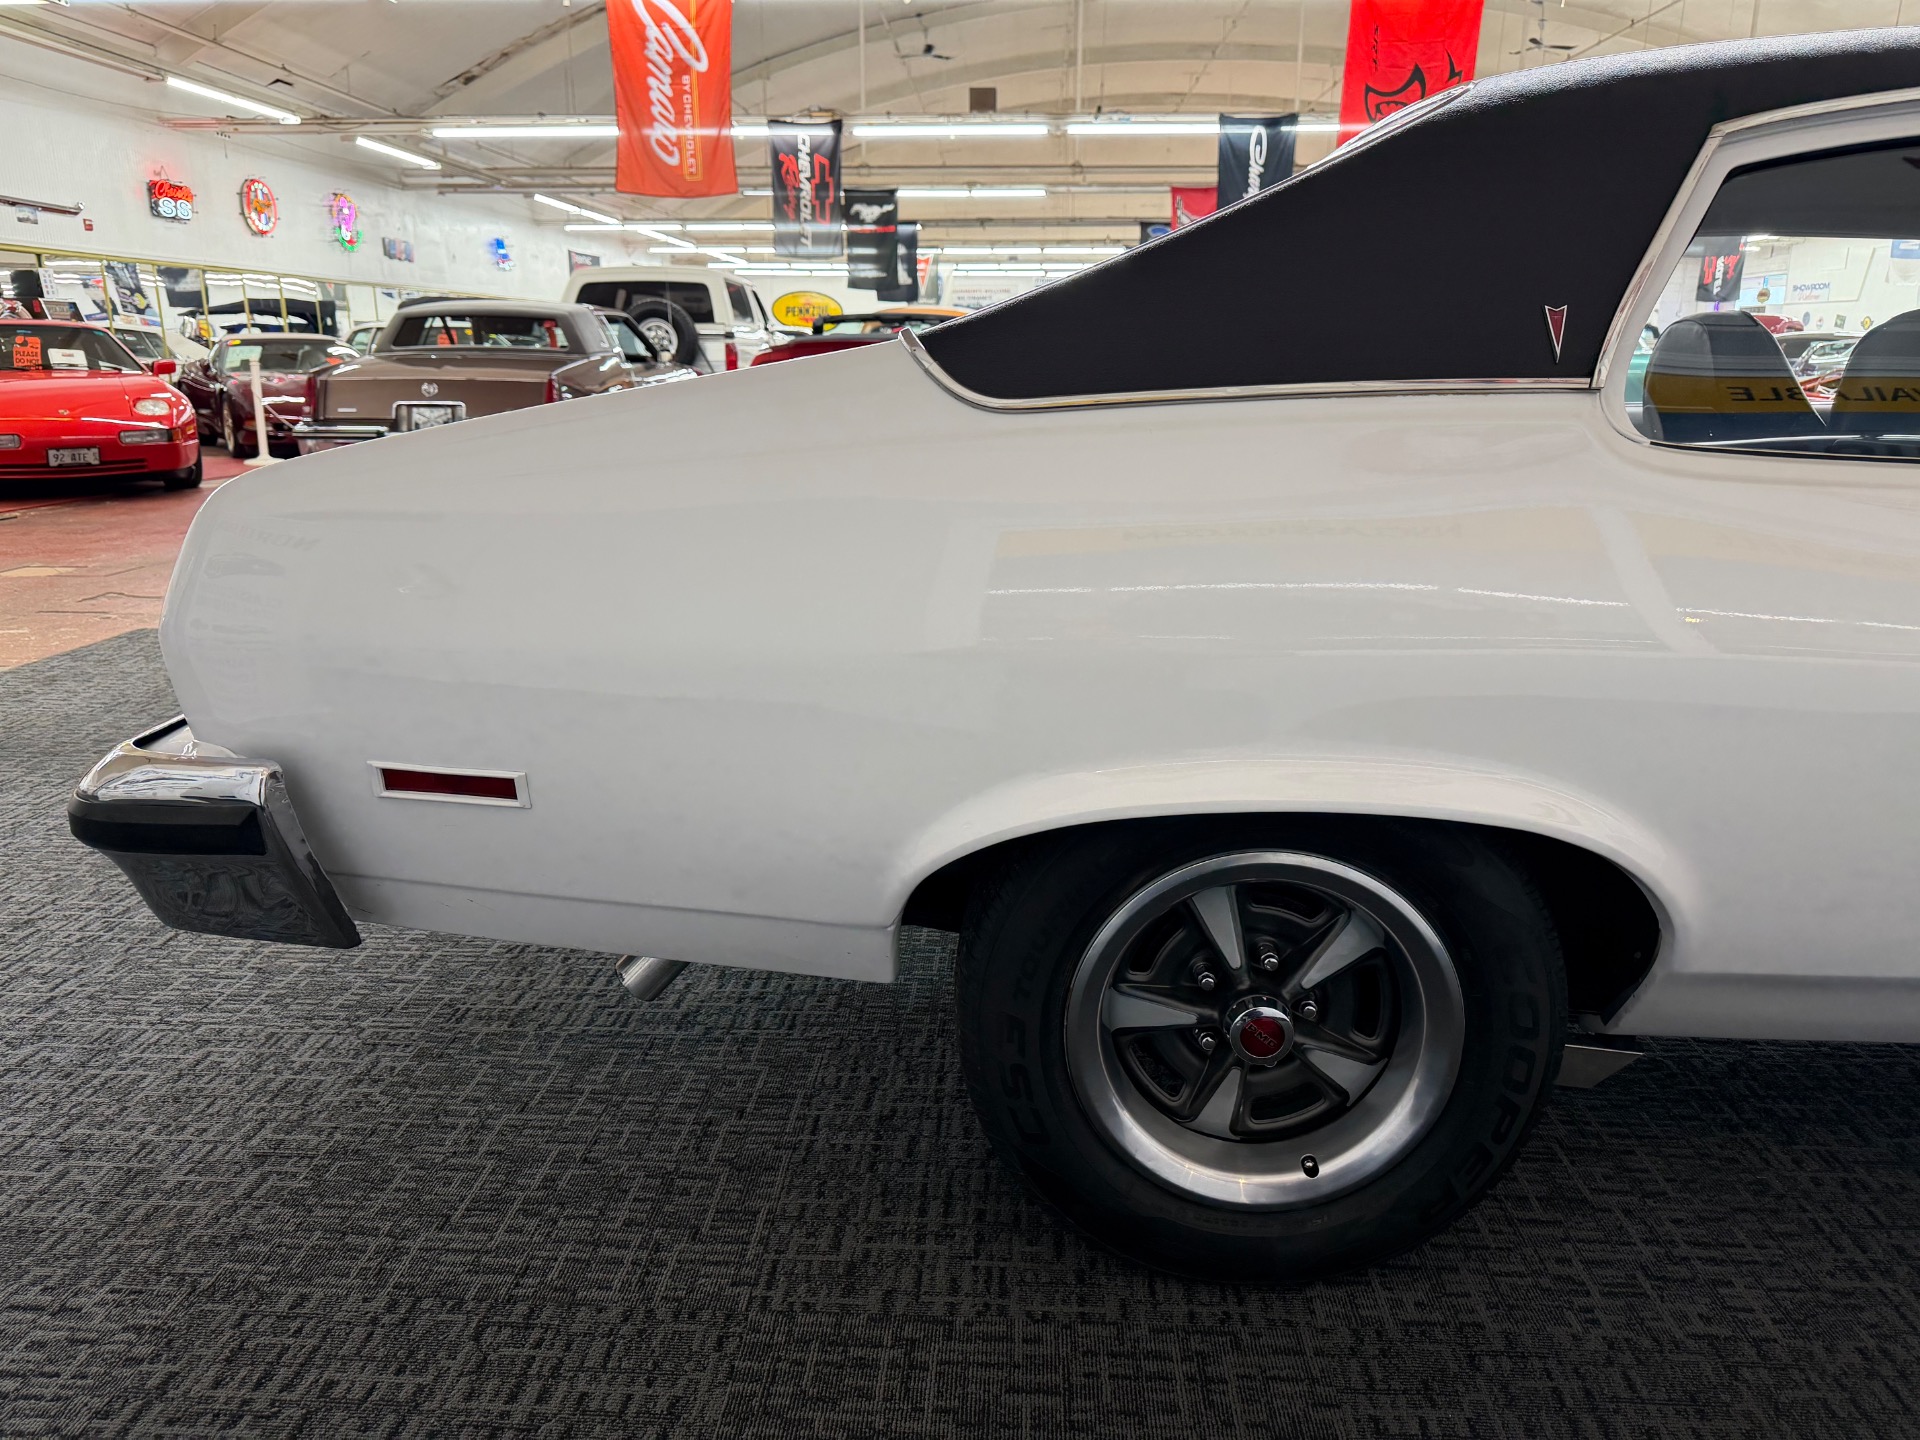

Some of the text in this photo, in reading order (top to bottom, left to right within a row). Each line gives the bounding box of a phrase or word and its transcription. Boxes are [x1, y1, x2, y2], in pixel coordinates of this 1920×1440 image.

[631, 0, 709, 166] Camaro
[681, 75, 697, 175] BY CHEVROLET
[778, 153, 799, 221] Racing
[797, 134, 812, 250] CHEVROLET
[14, 350, 39, 358] PLEASE
[14, 357, 40, 366] DO NOT
